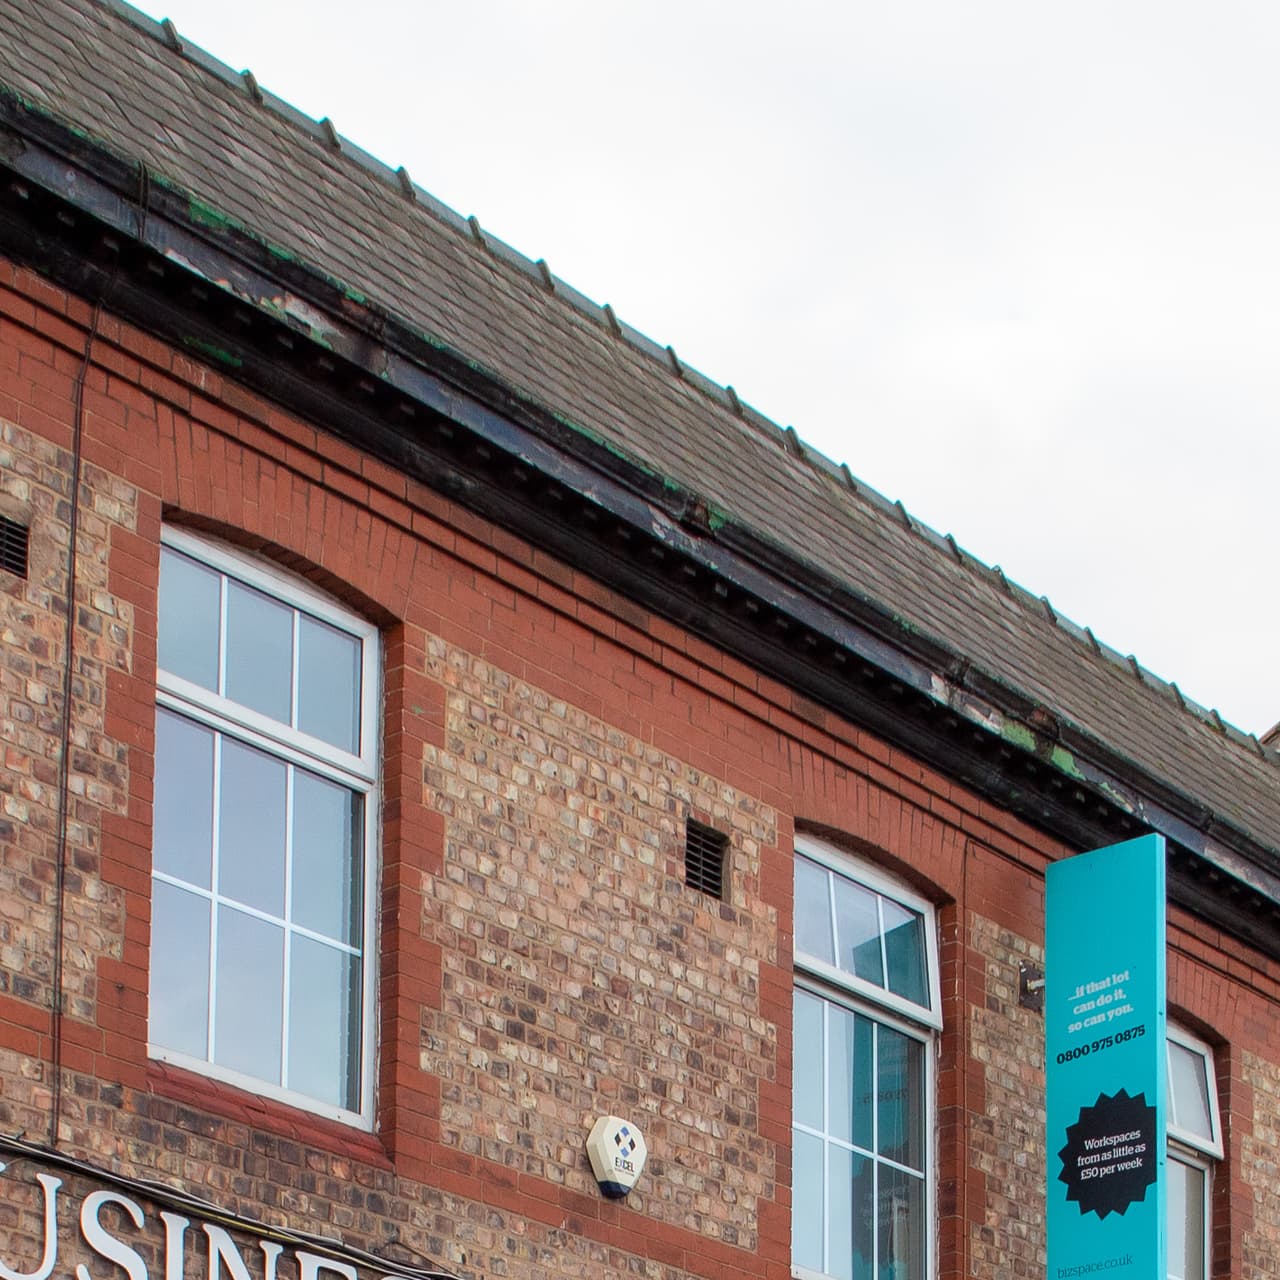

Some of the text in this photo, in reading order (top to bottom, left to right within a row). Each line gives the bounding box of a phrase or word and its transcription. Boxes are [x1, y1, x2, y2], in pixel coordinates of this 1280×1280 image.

[1086, 977, 1111, 994] that
[1112, 970, 1130, 985] lot
[1073, 1000, 1095, 1015] can
[1096, 993, 1113, 1006] do
[1068, 1021, 1083, 1034] so
[1083, 1014, 1106, 1028] can
[1056, 1025, 1145, 1065] 0800 975 0875
[1084, 1130, 1141, 1150] Workspaces
[1077, 1143, 1146, 1167] from as little as
[1080, 1157, 1143, 1180] £50 per week
[1057, 1253, 1133, 1279] bizspace.co.uk
